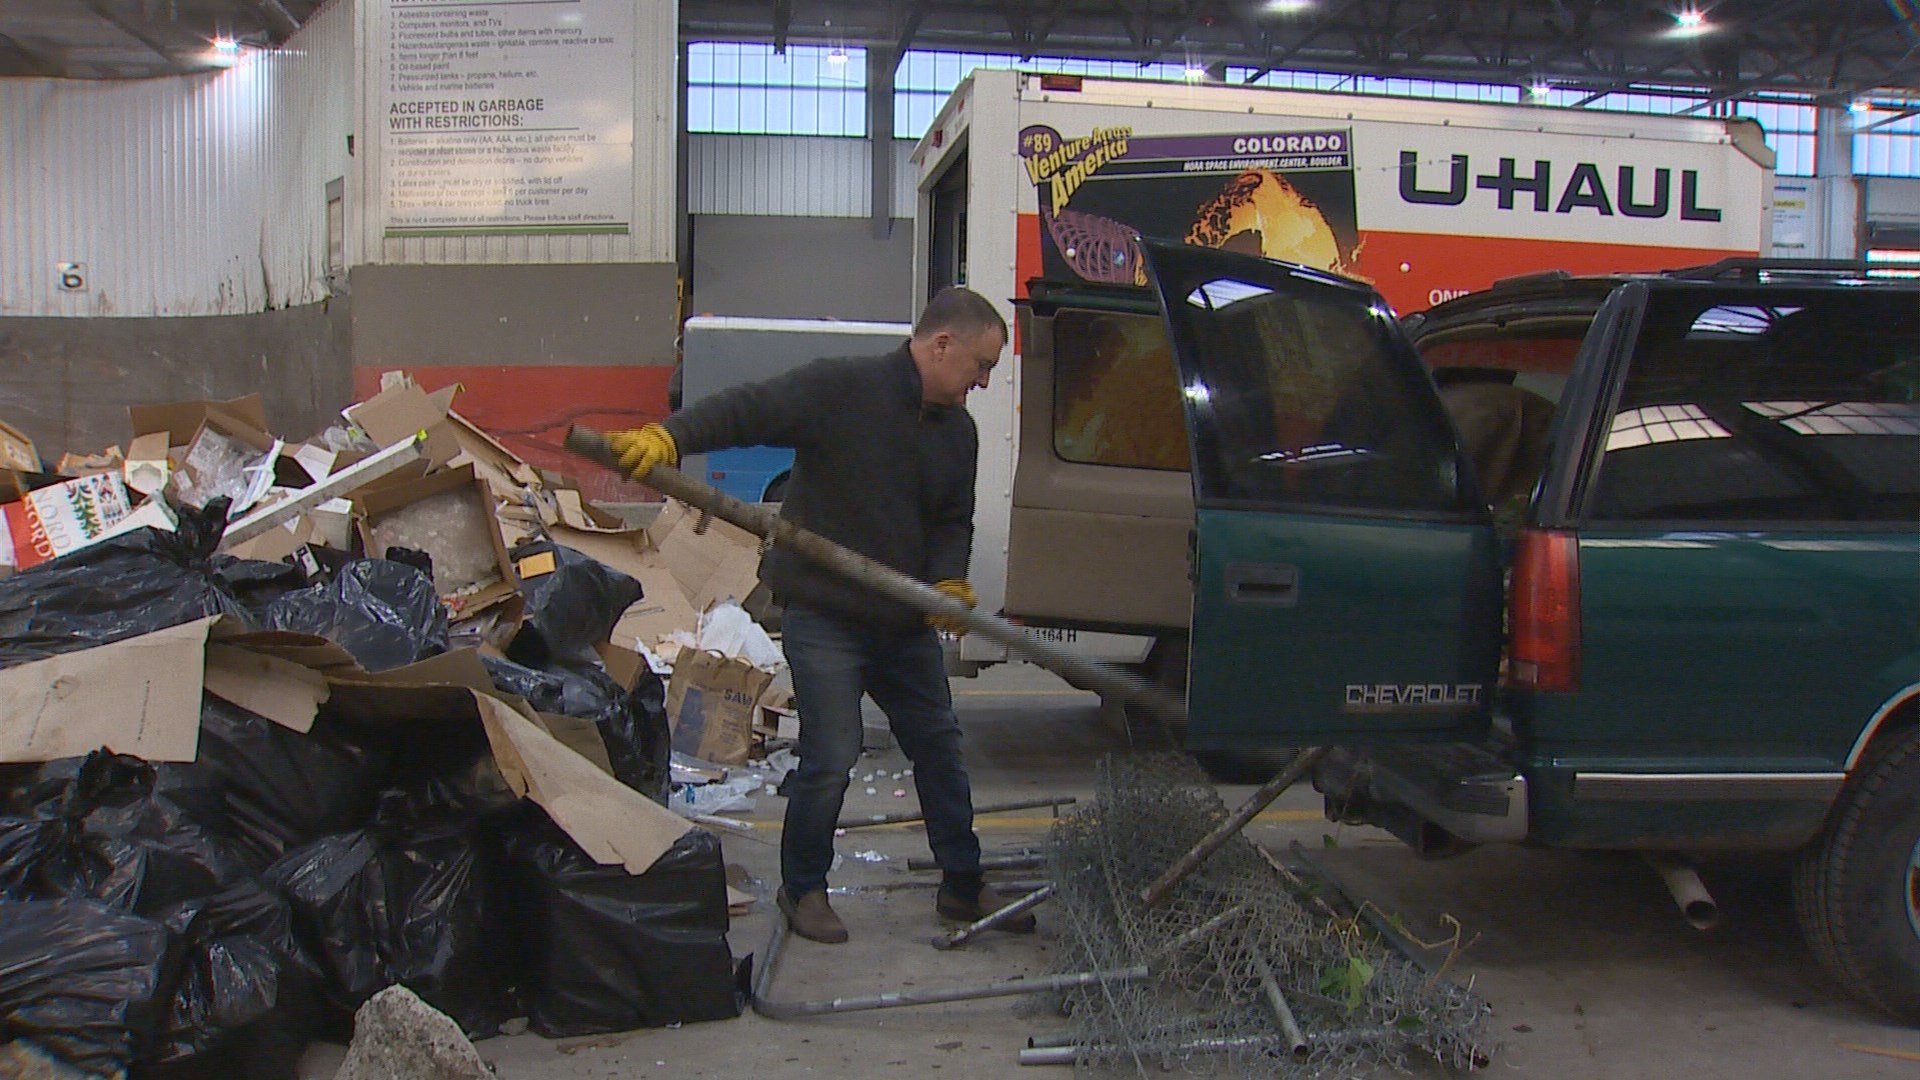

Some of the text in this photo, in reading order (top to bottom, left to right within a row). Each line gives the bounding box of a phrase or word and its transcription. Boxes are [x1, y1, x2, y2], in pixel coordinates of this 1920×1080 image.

[498, 28, 516, 36] other
[538, 27, 552, 35] with
[554, 27, 582, 36] mercury
[471, 39, 490, 47] waste
[562, 36, 588, 45] reactive
[389, 98, 544, 115] ACCEPTED IN GARBAGE
[389, 114, 524, 129] WITH RESTRICTIONS:
[1023, 132, 1052, 153] #89
[1233, 135, 1341, 153] COLORADO
[1024, 127, 1133, 186] Venture Across
[1205, 159, 1228, 170] SPACE
[1229, 157, 1278, 170] ENVIRONMENT
[1279, 156, 1309, 168] CENTER,
[1310, 155, 1343, 167] BOULDER
[1051, 139, 1129, 219] America
[1400, 150, 1722, 222] U-HAUL
[528, 187, 560, 195] customer
[516, 198, 532, 206] truck
[62, 263, 84, 289] 6
[1067, 629, 1077, 642] H
[1345, 683, 1483, 704] CHEVROLET
